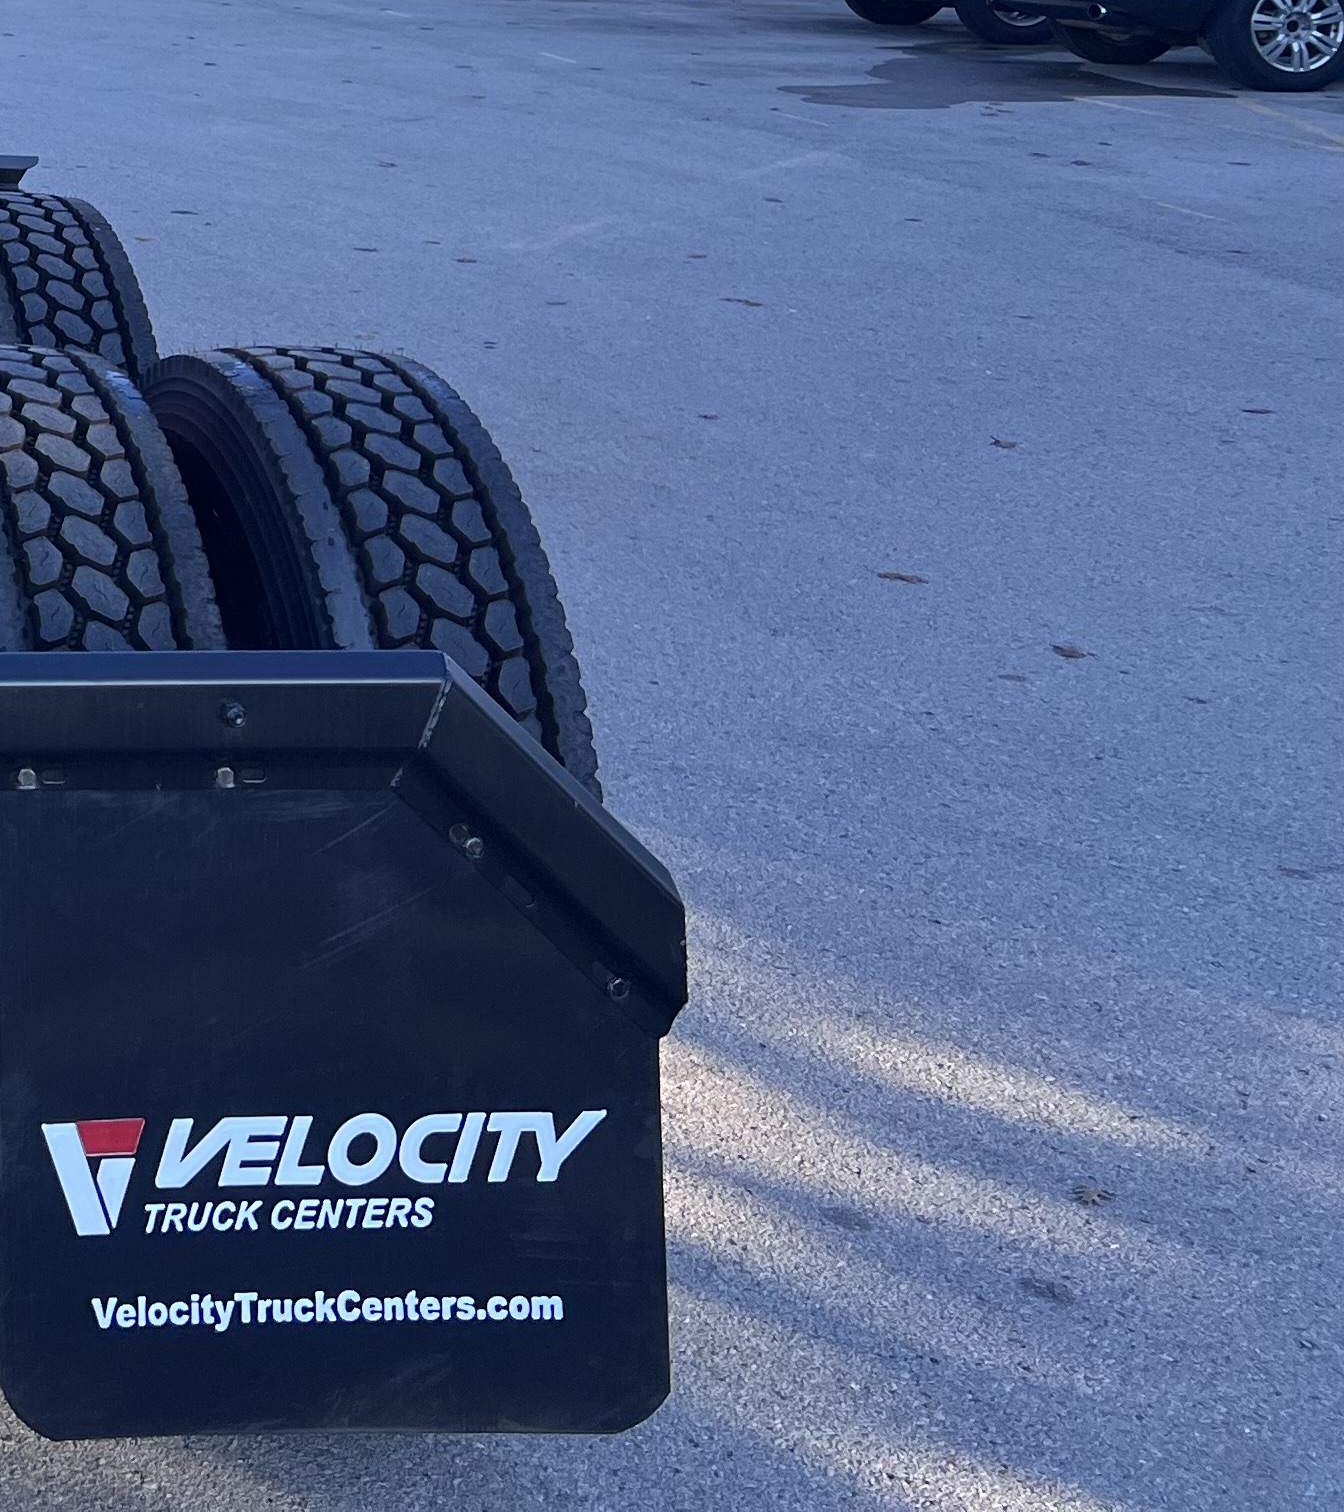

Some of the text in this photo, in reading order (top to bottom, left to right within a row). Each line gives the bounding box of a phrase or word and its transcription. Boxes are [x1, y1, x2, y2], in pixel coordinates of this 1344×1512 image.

[155, 1109, 608, 1188] VELOCITY
[143, 1197, 435, 1234] TRUCK CENTERS
[92, 1290, 564, 1332] VelocityTruckCenters.com
